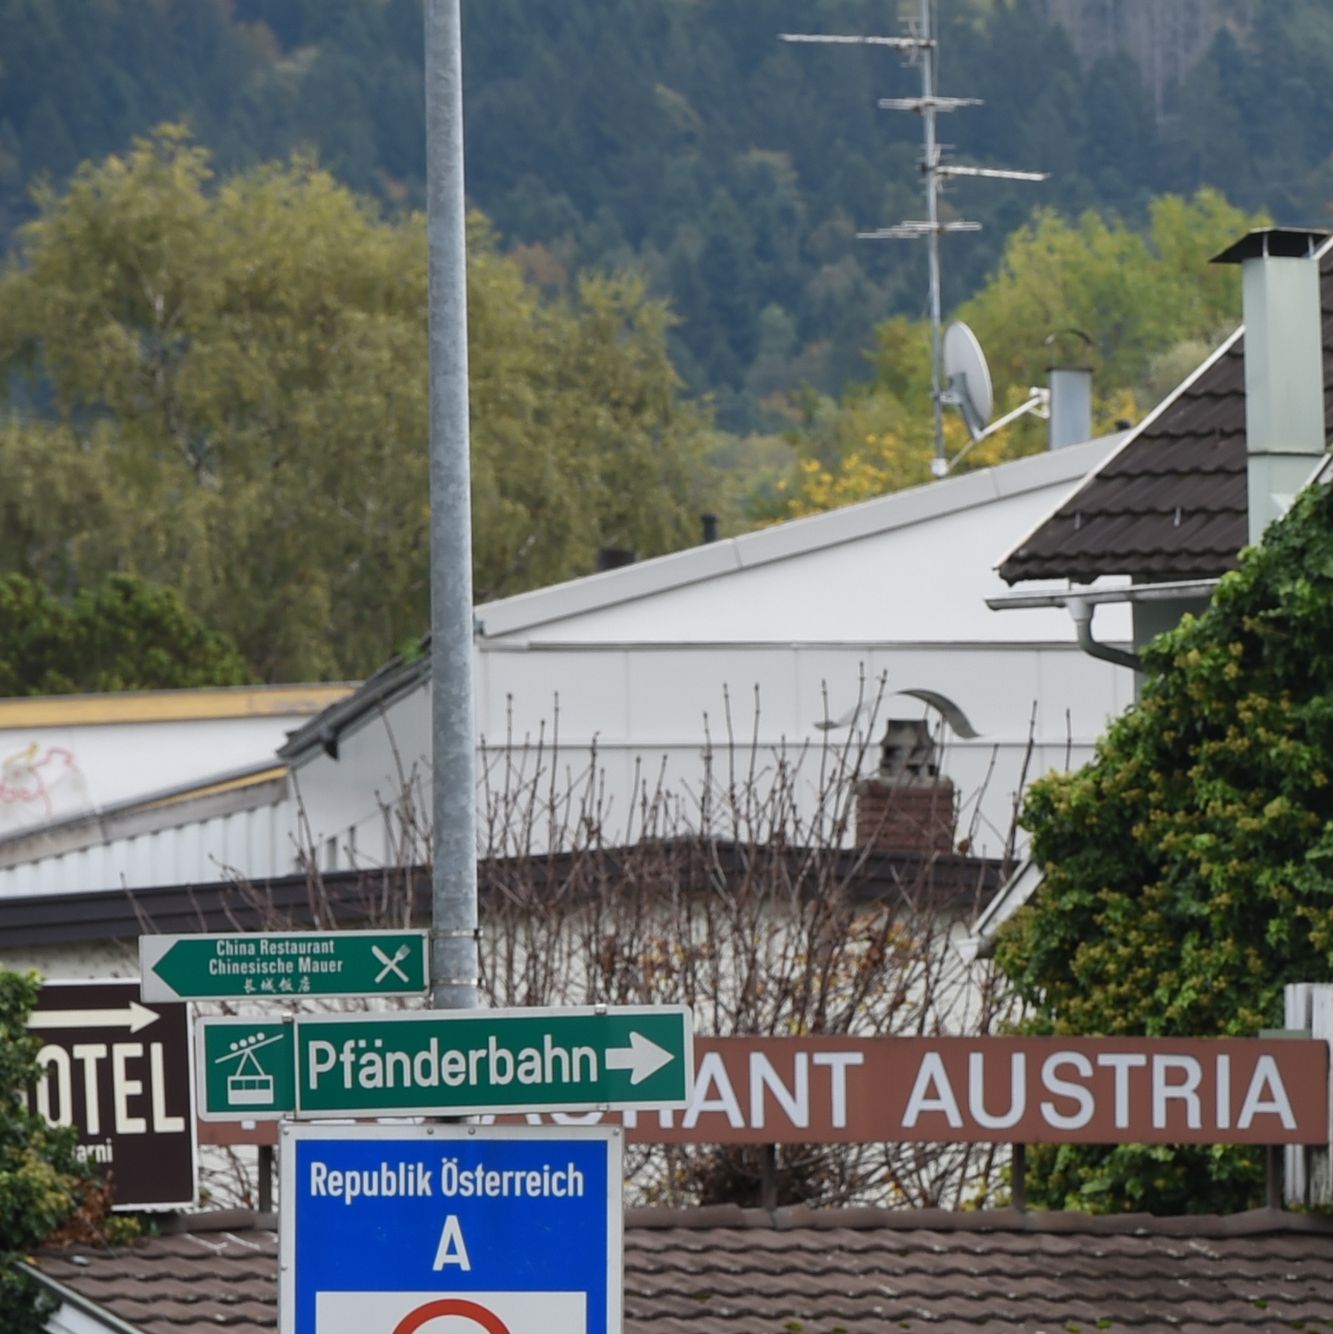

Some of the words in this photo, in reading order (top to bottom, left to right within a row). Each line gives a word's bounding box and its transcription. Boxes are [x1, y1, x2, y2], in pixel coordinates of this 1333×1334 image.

[209, 958, 294, 975] Chinesische
[297, 956, 343, 972] Mauer
[216, 940, 256, 956] China
[260, 939, 335, 955] Restaurant
[34, 1042, 185, 1135] OTEL
[308, 1034, 598, 1091] Pfänderbahn
[902, 1050, 1297, 1131] AUSTRIA
[75, 1137, 113, 1164] arni
[310, 1161, 432, 1205] Republik
[441, 1157, 584, 1198] Österreich
[432, 1215, 472, 1272] A
